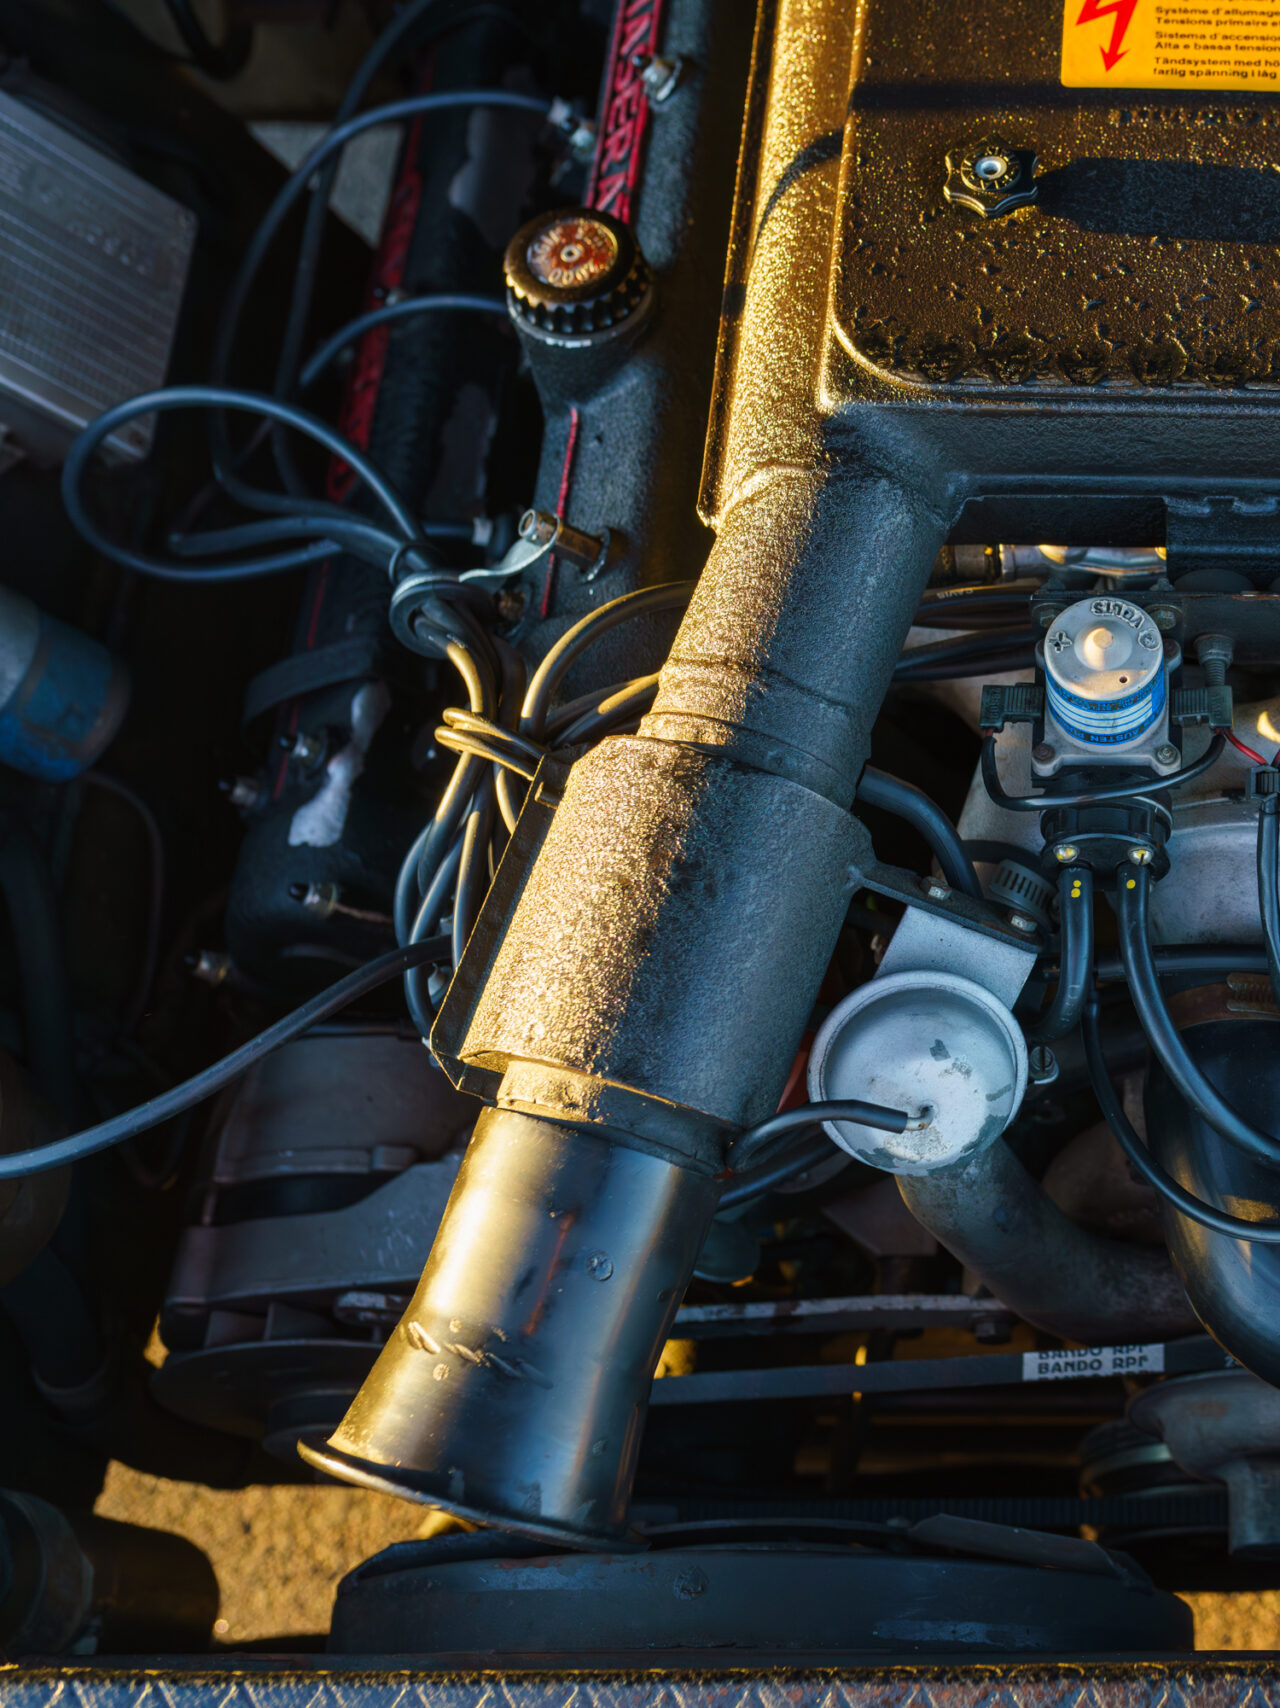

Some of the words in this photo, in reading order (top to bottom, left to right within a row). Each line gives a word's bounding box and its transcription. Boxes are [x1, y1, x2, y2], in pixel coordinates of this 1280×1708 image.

[1155, 6, 1209, 16] Système
[1156, 17, 1213, 26] Tensions
[1215, 18, 1268, 27] primaire
[1155, 31, 1206, 40] Sistema
[1155, 41, 1180, 50] Alta
[1194, 43, 1231, 51] bassa
[1154, 57, 1231, 67] Tändsystem
[1234, 59, 1261, 68] med
[1153, 67, 1186, 77] farlig
[1189, 69, 1248, 79] spänning
[1258, 69, 1277, 79] låg
[1091, 600, 1145, 629] VOLTS
[1090, 728, 1141, 744] AUSTEN
[1038, 1358, 1103, 1375] BANDO
